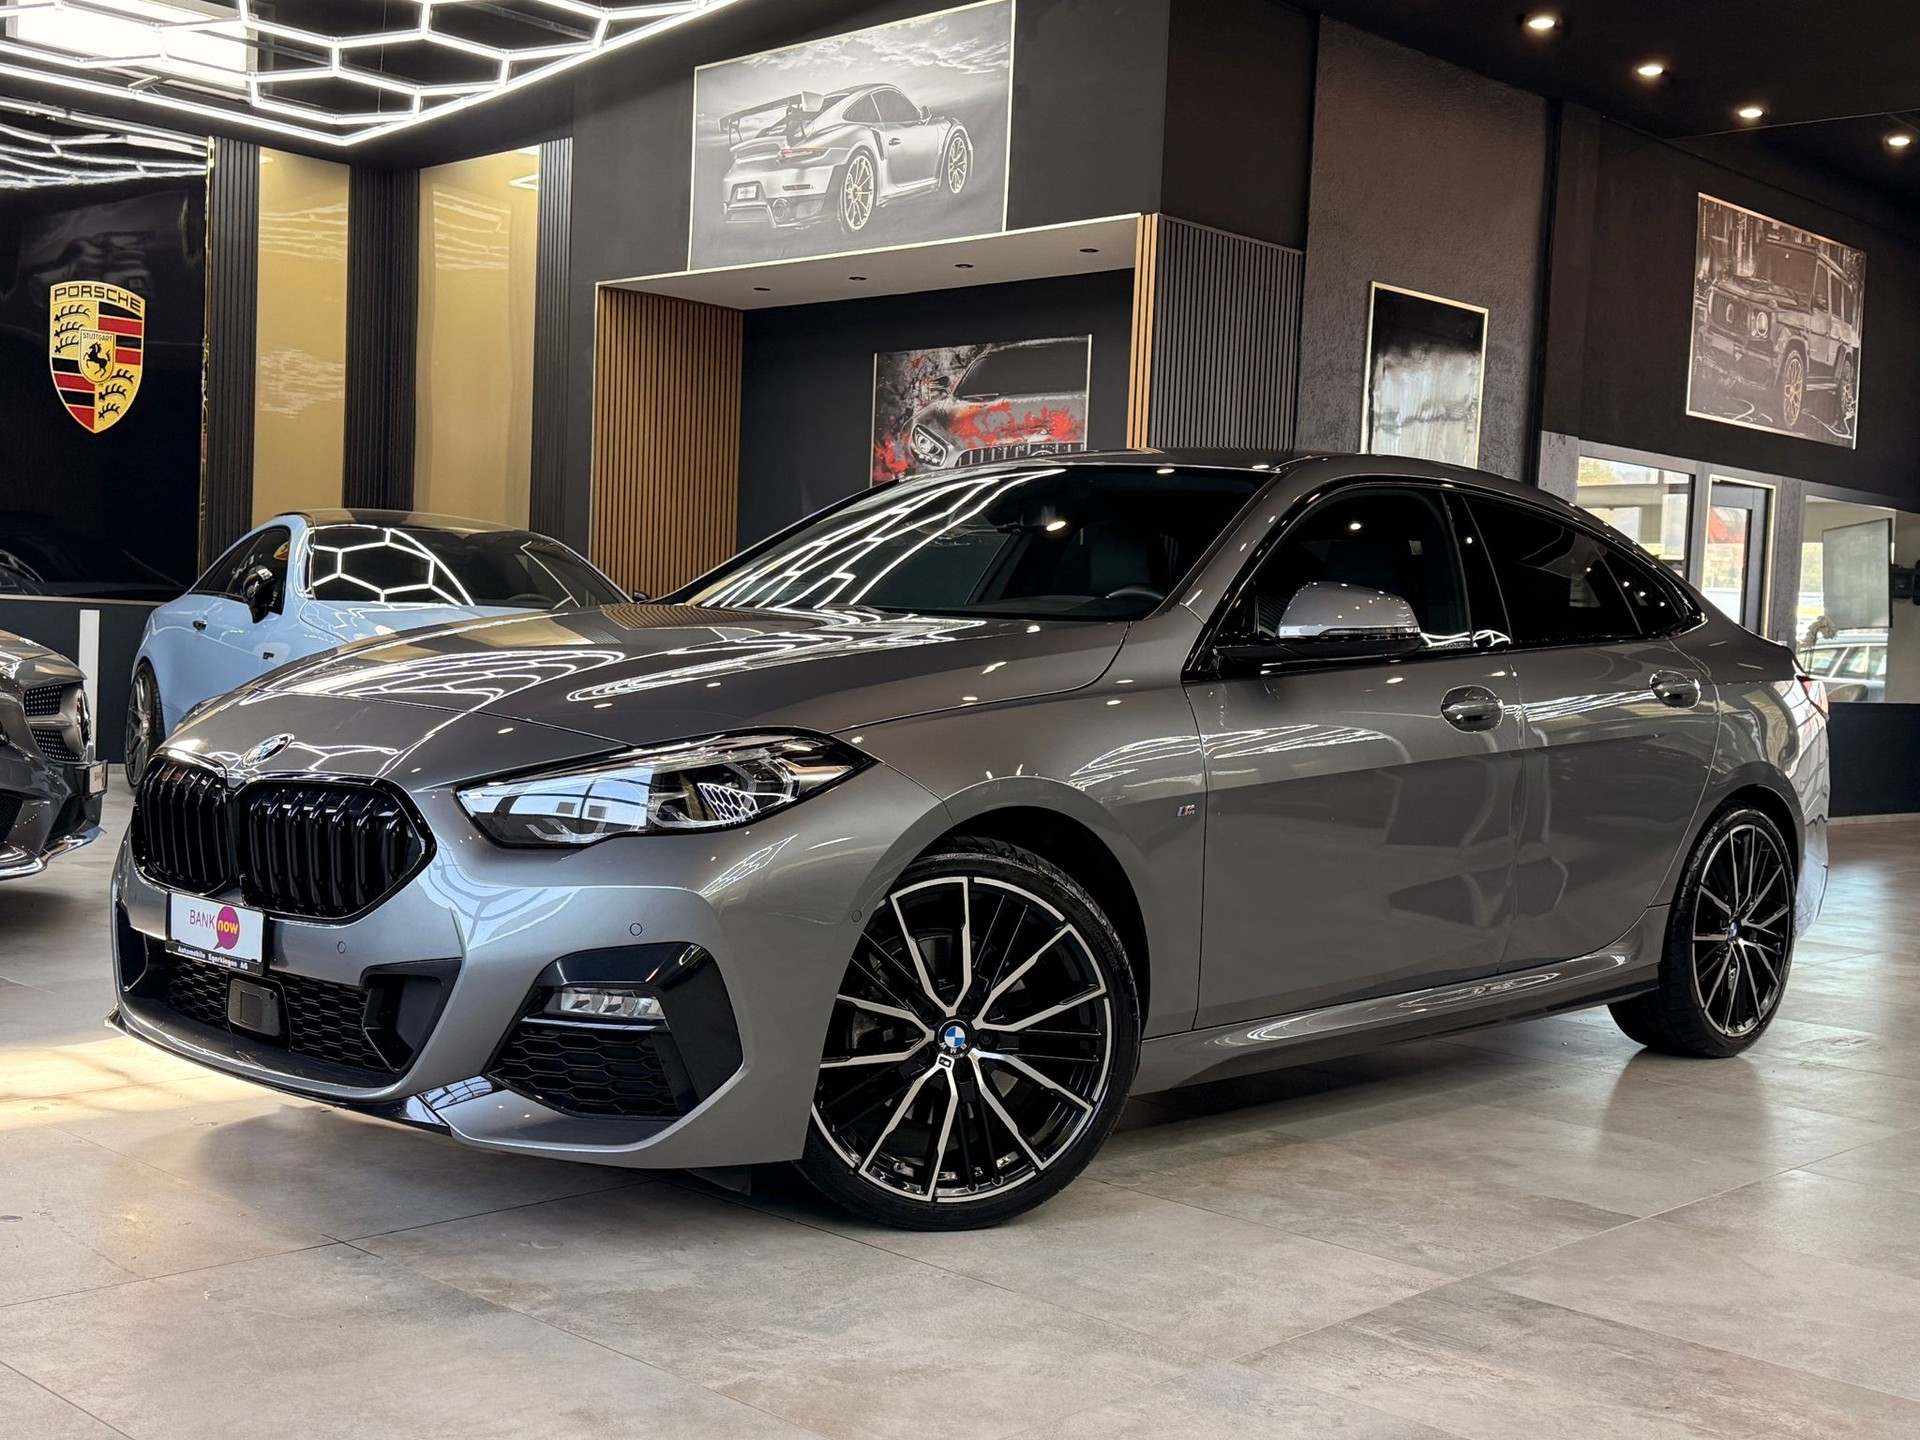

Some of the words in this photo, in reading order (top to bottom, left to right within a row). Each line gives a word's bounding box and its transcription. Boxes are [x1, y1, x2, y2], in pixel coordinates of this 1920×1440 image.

[54, 285, 141, 313] PORSCHE
[83, 332, 112, 342] STUTTGART
[190, 909, 216, 929] BANK
[217, 919, 239, 935] now
[177, 945, 206, 959] Automobile
[208, 953, 237, 968] Egerkingen
[240, 961, 248, 970] AG
